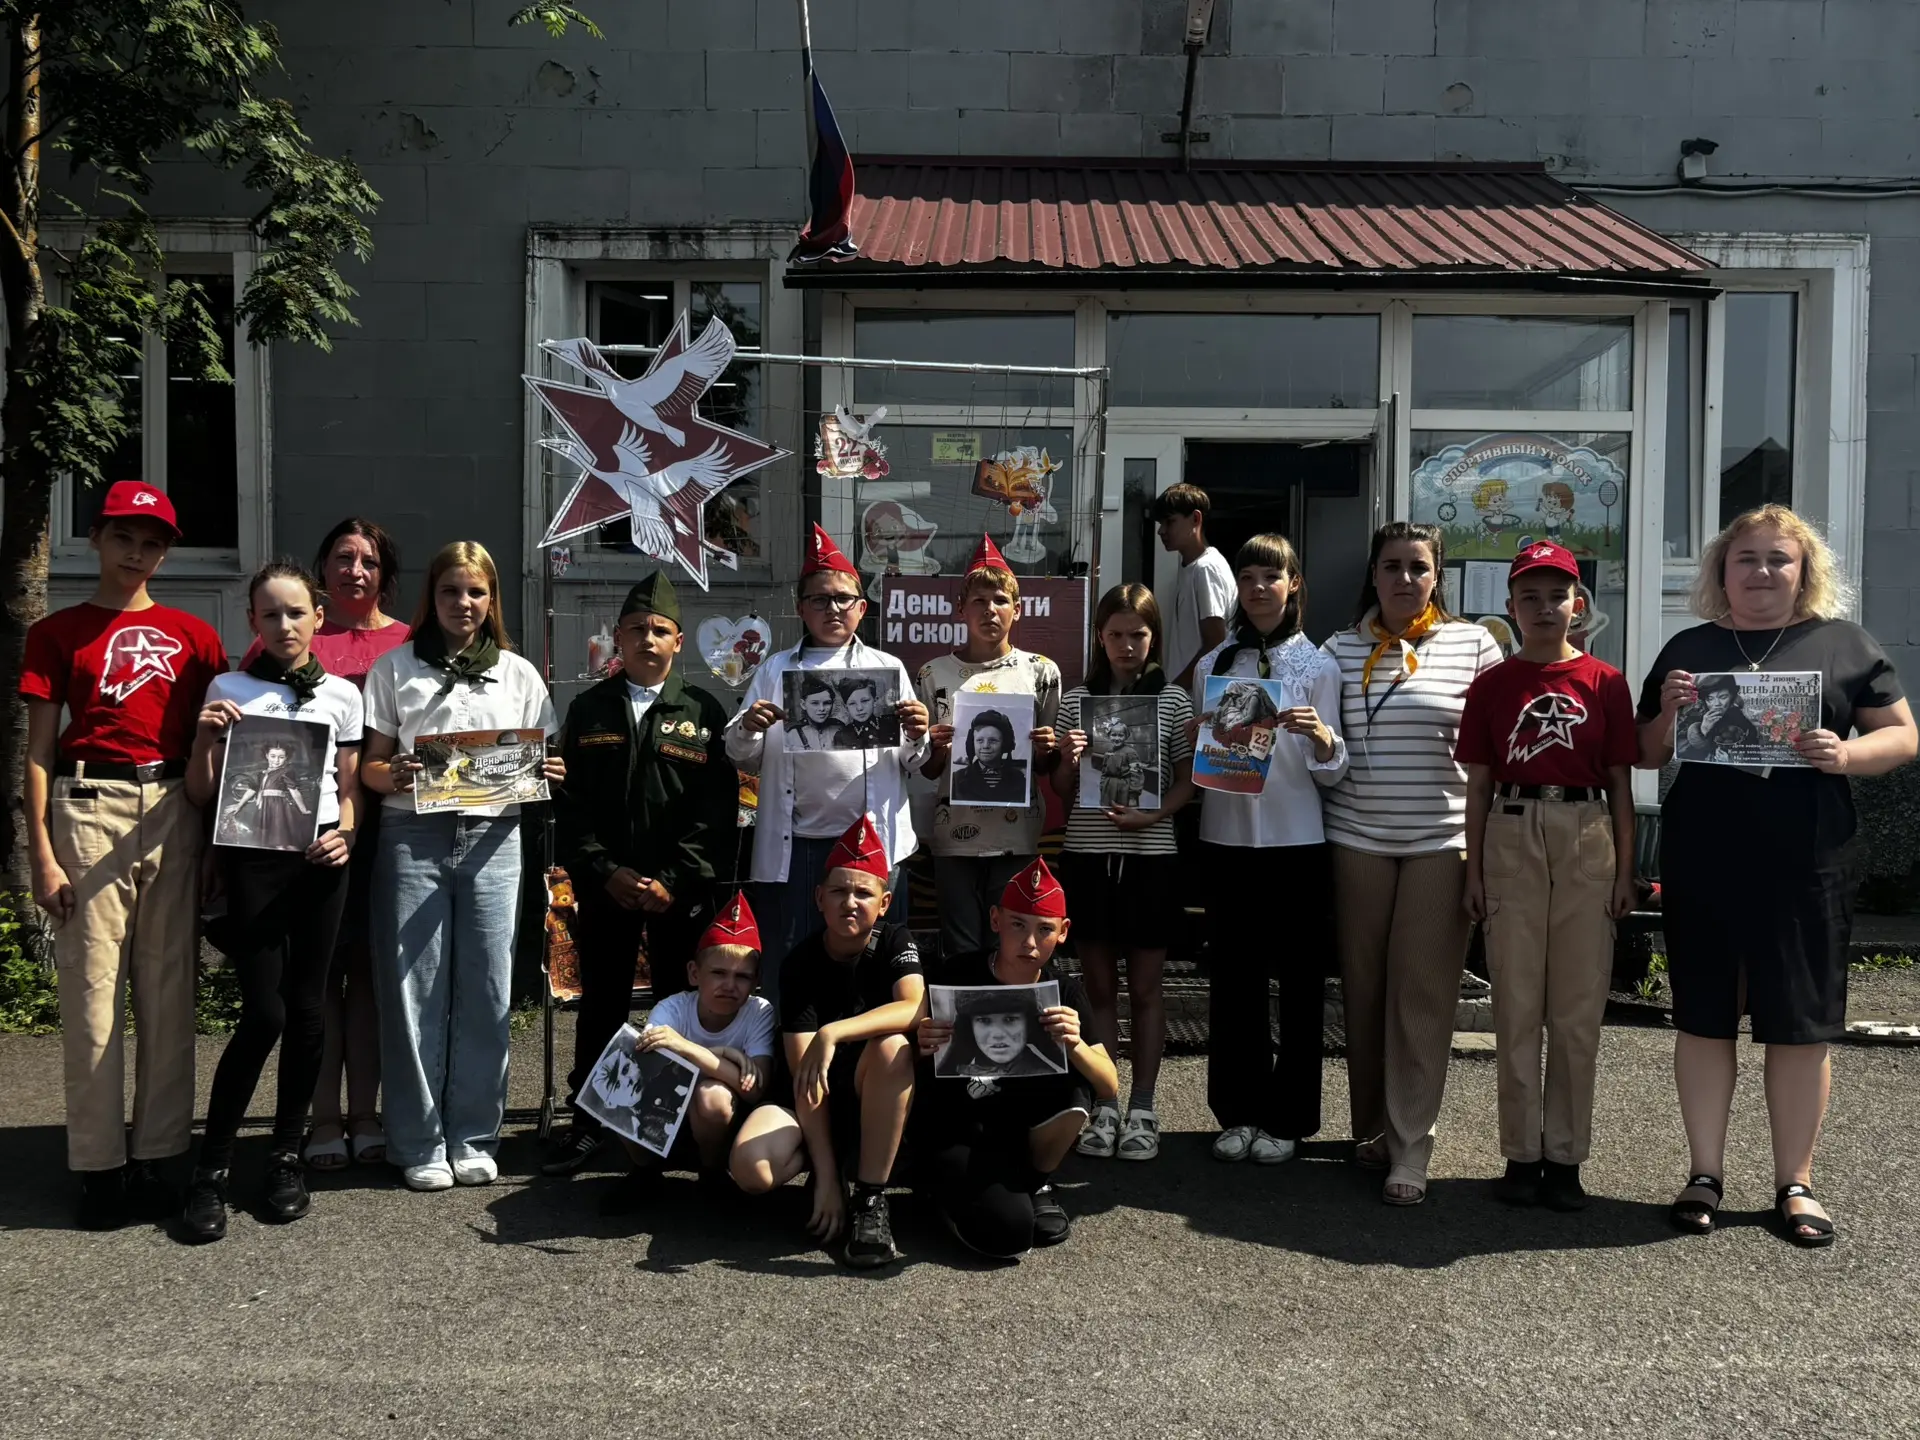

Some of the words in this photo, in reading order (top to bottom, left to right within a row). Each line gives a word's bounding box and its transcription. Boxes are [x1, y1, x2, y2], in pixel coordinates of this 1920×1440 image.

[835, 437, 860, 457] 22
[1441, 443, 1537, 487] СПОРТИВНЫЙ
[1539, 446, 1593, 487] УГОЛОК
[886, 589, 953, 619] День
[908, 622, 968, 647] скор
[1759, 674, 1770, 683] 22
[1738, 685, 1768, 695] ДЕНЬ
[1772, 685, 1819, 694] ПАМЯТИ
[281, 702, 316, 714] Balance
[1254, 732, 1269, 747] 22
[474, 755, 502, 770] День
[422, 800, 433, 809] 22
